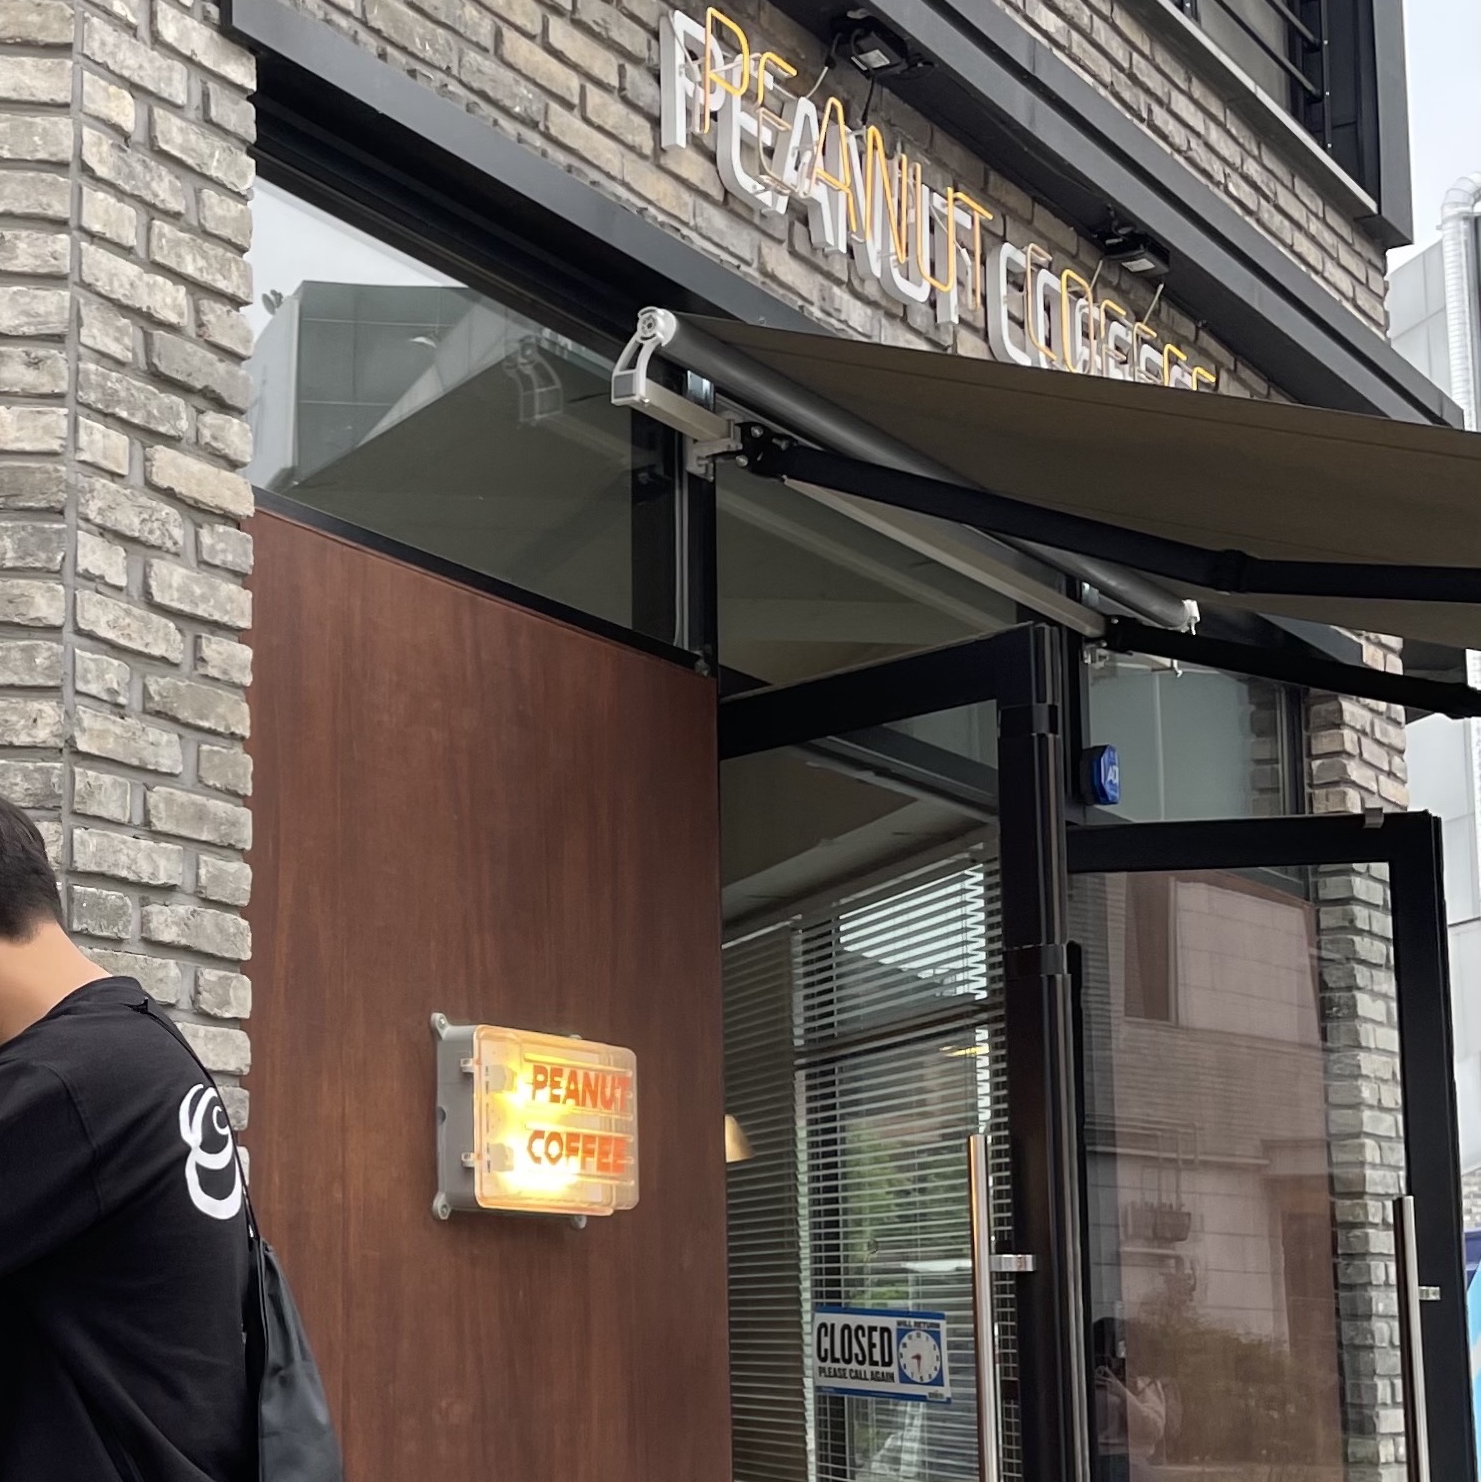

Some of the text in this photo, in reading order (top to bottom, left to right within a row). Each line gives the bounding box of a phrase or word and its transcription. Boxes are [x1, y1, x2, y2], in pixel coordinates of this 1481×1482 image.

[659, 7, 993, 325] PEANUT
[532, 1065, 630, 1111] PEANUT
[527, 1130, 626, 1173] COFFEE
[817, 1322, 893, 1367] CLOSED
[818, 1367, 895, 1383] PLEASE CALL AGAIN
